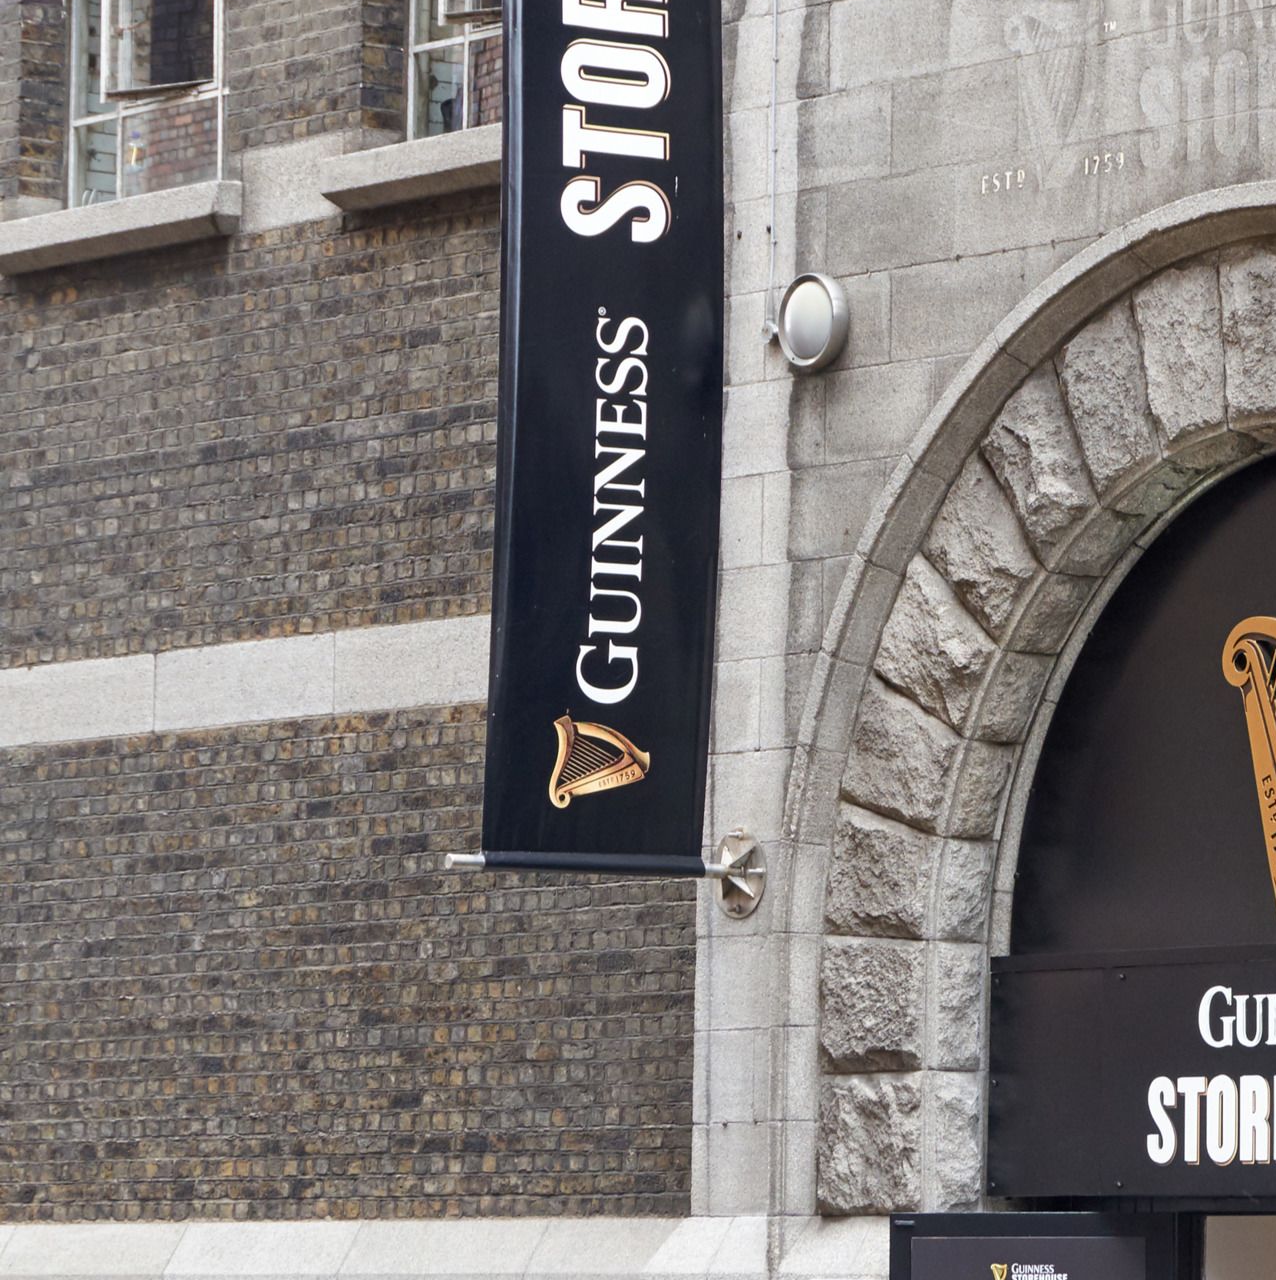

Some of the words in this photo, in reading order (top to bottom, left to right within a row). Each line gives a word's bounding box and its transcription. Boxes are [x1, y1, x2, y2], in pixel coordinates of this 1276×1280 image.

[575, 316, 649, 704] GUINNESS
[615, 769, 636, 783] 1759
[1011, 1263, 1055, 1274] GUINNESS
